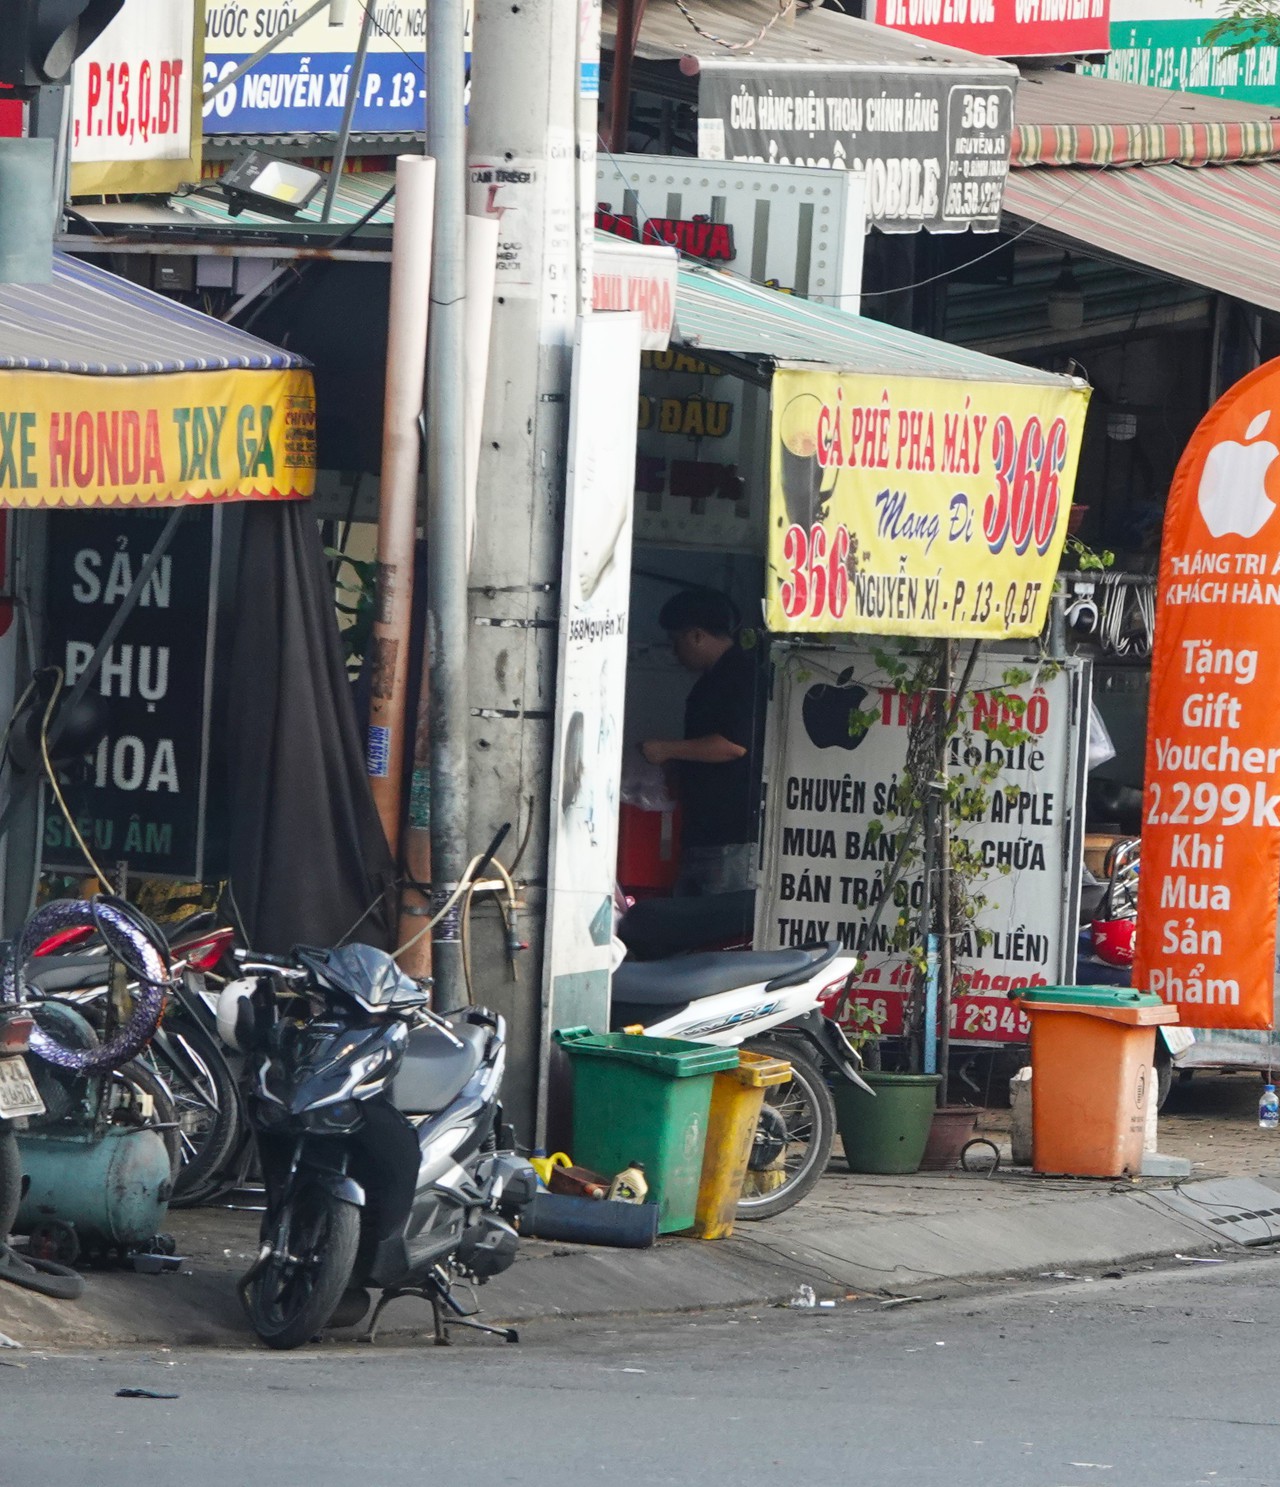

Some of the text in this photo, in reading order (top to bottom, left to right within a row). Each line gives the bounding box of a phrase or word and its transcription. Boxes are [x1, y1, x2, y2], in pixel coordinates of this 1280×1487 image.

[202, 61, 238, 118] 66
[241, 57, 324, 109] NGUYỄN
[325, 65, 351, 108] XÍ
[389, 72, 416, 107] 13
[731, 84, 939, 139] CỬA HÀNG ĐIỆN THOẠI CHÍNH HÃNG
[962, 94, 1000, 129] 366
[0, 411, 38, 489] XE
[50, 408, 165, 489] HONDA
[172, 405, 228, 483] TAY
[236, 404, 275, 480] GA
[817, 387, 987, 475] CÀ PHÊ PHA MÁY
[983, 415, 1068, 556] 366
[875, 488, 974, 556] Mang Đi
[72, 535, 173, 608] SẢN
[781, 524, 850, 619] 366
[855, 556, 919, 620] NGUYỄN
[920, 567, 942, 620] XÍ
[971, 581, 994, 623] 13
[1019, 583, 1042, 624] BT
[1235, 553, 1265, 575] TRI
[1165, 579, 1227, 606] KHÁCH
[64, 640, 171, 713] PHỤ
[1182, 639, 1258, 685] Tặng
[1182, 692, 1243, 729] Gift
[786, 773, 867, 814] CHUYÊN
[872, 773, 912, 817] SẢ
[991, 789, 1054, 827] APPLE
[123, 814, 173, 855] ÂM
[782, 826, 837, 859] MUA
[981, 836, 1046, 871] CHỮA
[1171, 834, 1225, 869] Khi
[780, 868, 832, 904] BÁN
[839, 869, 884, 907] TRẢ
[1160, 875, 1231, 911] Mua
[777, 918, 830, 947] THAY
[1161, 918, 1222, 956] Sản
[1149, 963, 1240, 1005] Phẩm
